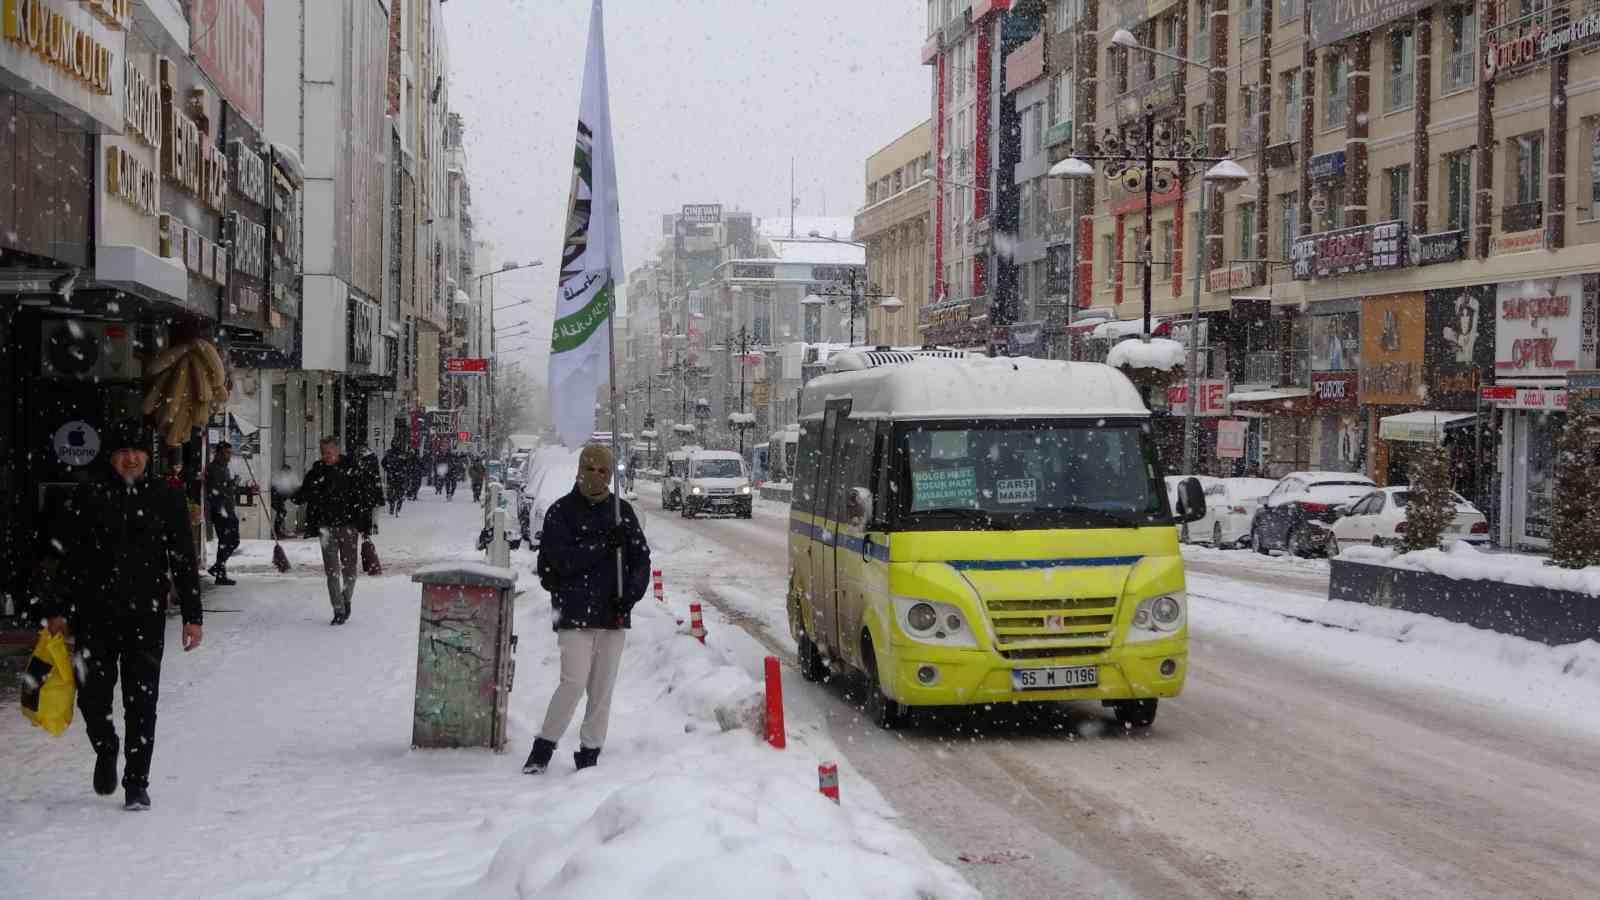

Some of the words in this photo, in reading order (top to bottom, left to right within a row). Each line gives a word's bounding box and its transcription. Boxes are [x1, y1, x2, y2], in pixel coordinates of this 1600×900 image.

[58, 446, 95, 457] iPhone
[1022, 671, 1037, 686] 65
[1047, 671, 1055, 685] M
[1065, 668, 1095, 684] 0196
